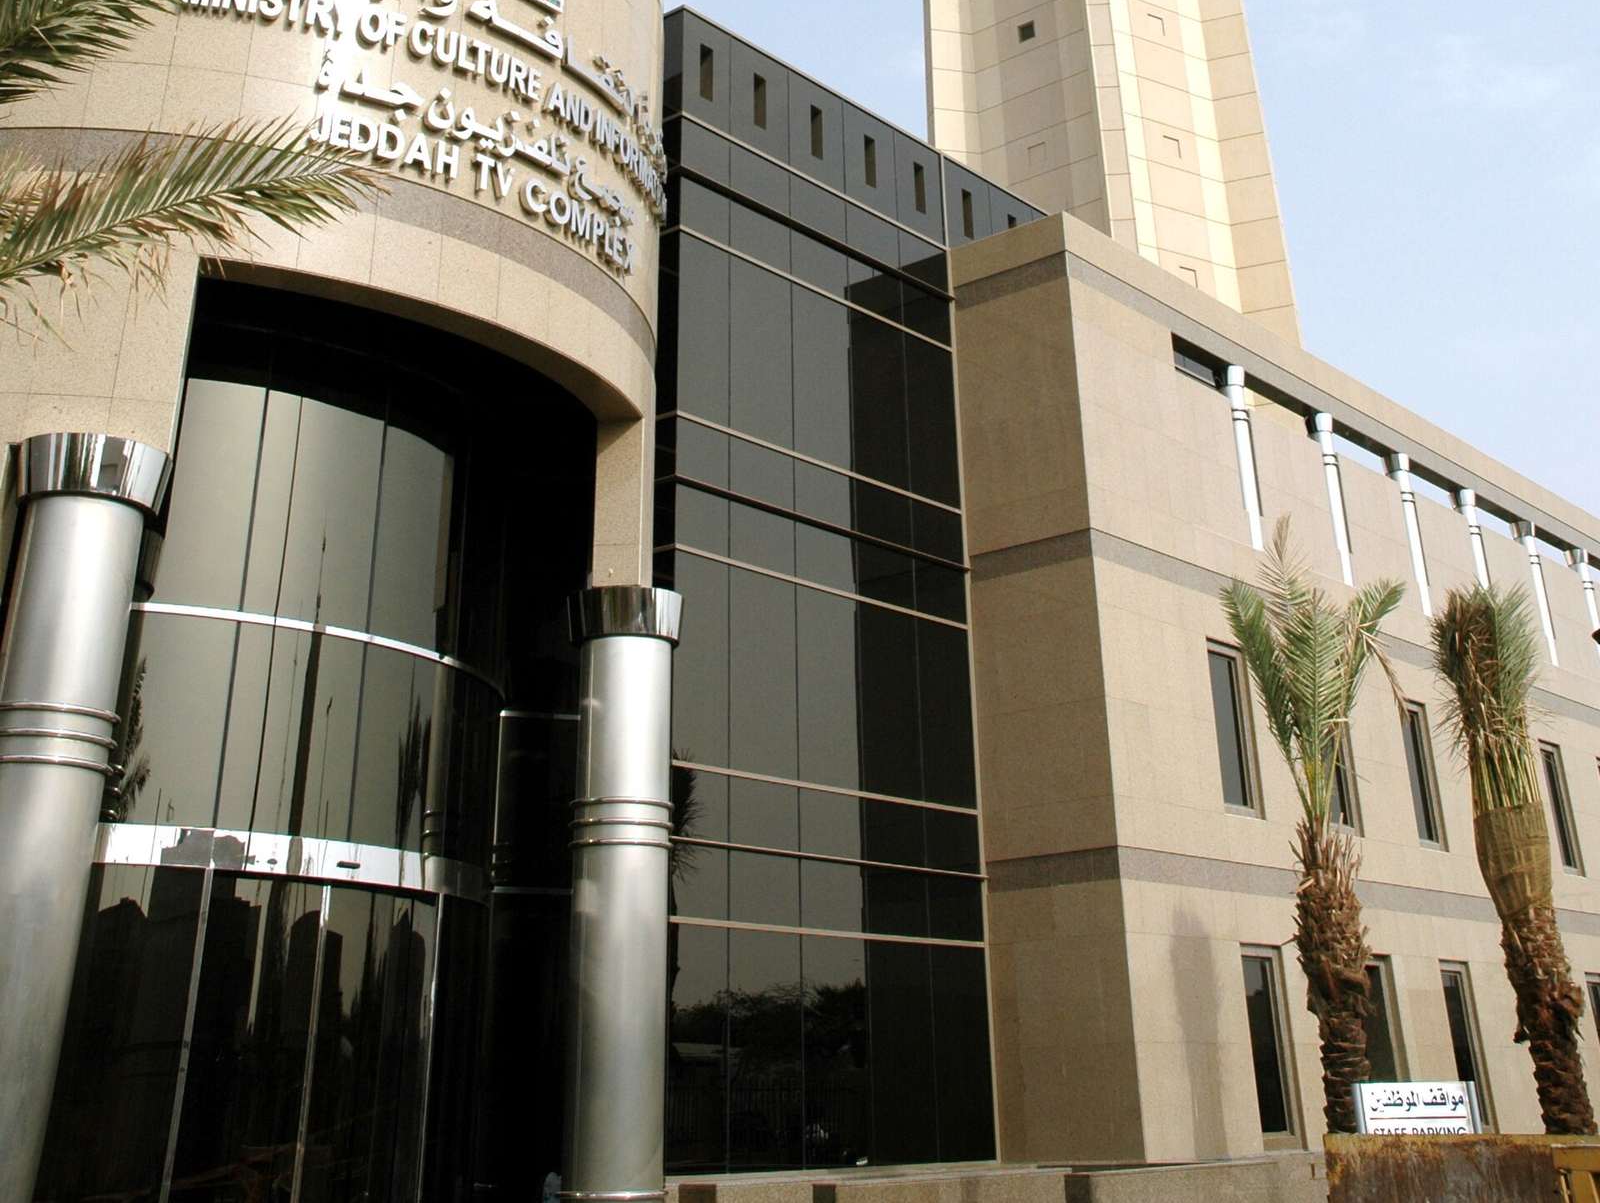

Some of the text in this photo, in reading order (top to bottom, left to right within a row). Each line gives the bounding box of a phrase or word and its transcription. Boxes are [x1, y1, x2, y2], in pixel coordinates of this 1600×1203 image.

[316, 46, 426, 122] جدة
[358, 9, 408, 48] OF
[408, 20, 543, 102] CULTURE
[546, 82, 593, 133] AND
[591, 108, 668, 226] INFORMA
[423, 87, 571, 176] تلفزيون
[309, 106, 635, 274] JEDDAH TV COMPLEX
[1370, 1087, 1465, 1112] مواقف الموظفين
